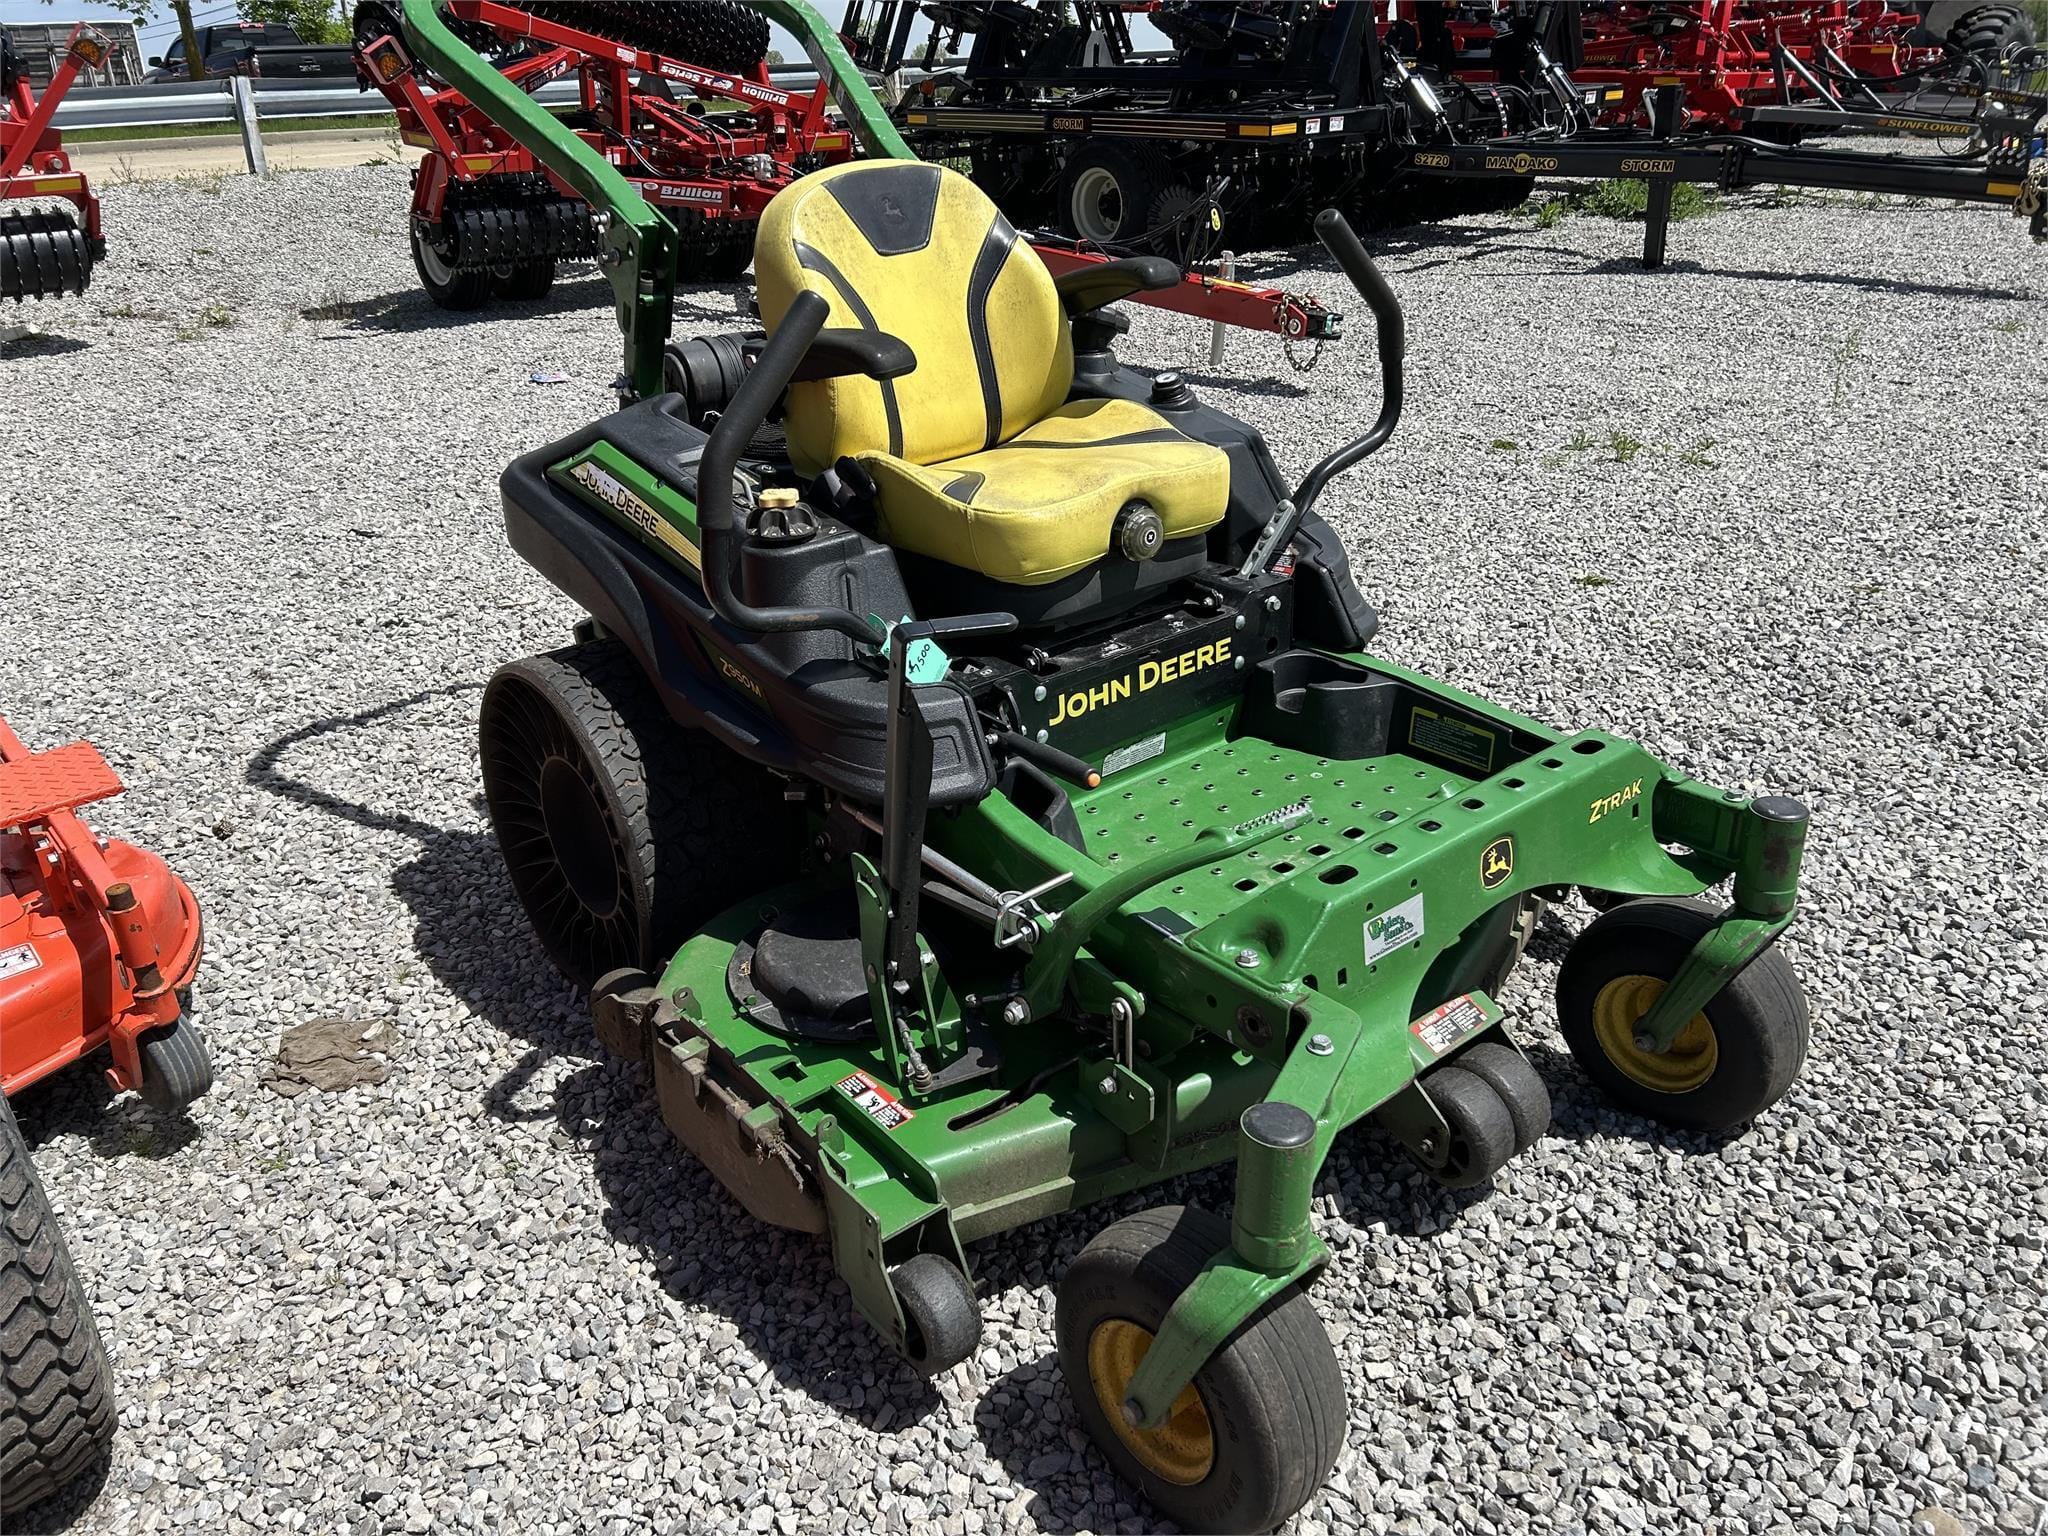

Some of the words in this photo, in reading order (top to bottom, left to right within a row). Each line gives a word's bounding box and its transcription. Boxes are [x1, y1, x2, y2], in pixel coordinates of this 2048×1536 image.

[660, 64, 700, 82] Series
[741, 85, 787, 105] Brillion
[1053, 118, 1084, 130] STORM
[1887, 118, 1971, 134] SUNFLOWER
[1414, 153, 1450, 167] S2720
[1486, 156, 1558, 170] MANDAKO
[1621, 158, 1675, 172] STORM
[661, 185, 722, 199] Brillion
[615, 486, 659, 537] DEERE
[719, 656, 762, 698] Z950M
[1049, 674, 1131, 727] JOHN
[1138, 636, 1232, 693] DEERE
[1589, 776, 1643, 825] ZTRAK
